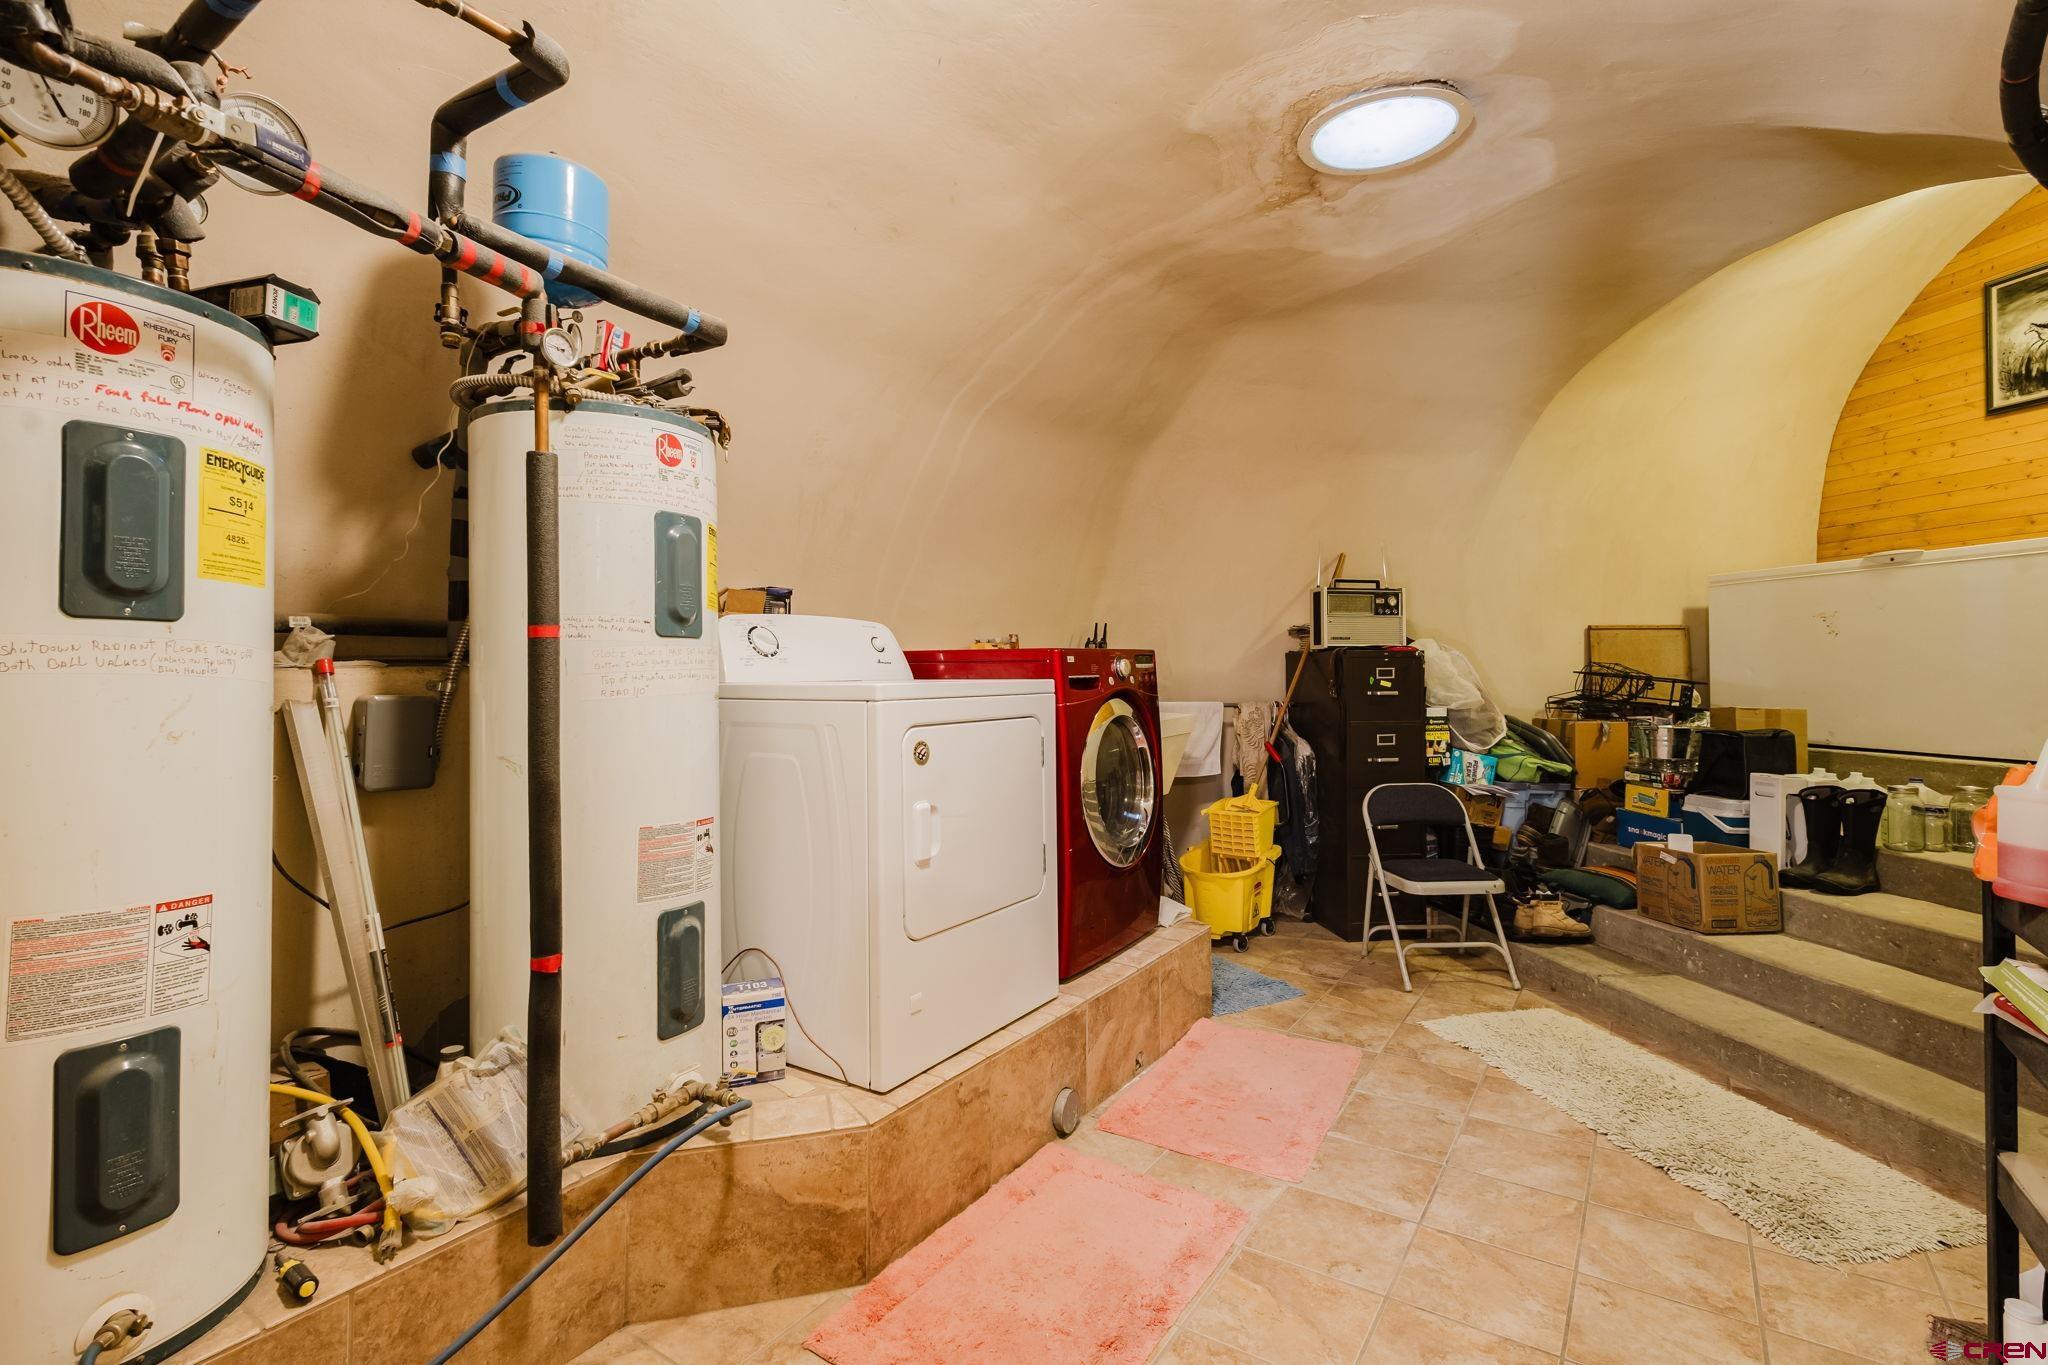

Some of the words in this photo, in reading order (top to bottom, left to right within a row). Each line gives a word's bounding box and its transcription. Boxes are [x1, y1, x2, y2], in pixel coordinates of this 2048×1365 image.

[1, 66, 11, 76] 40
[1, 80, 11, 90] 20
[81, 94, 94, 105] 160
[78, 108, 91, 118] 180
[251, 110, 261, 119] 100
[65, 119, 79, 128] 200
[264, 117, 274, 126] 120
[80, 303, 137, 347] Rheem
[143, 321, 192, 341] RHEEMGLAS
[157, 334, 178, 345] FURY
[658, 434, 684, 463] Rheem
[206, 453, 265, 483] ENERGYGUIDE
[225, 533, 246, 545] 4825
[1705, 864, 1741, 875] WATER
[170, 896, 210, 910] DANGER
[737, 981, 768, 991] T103
